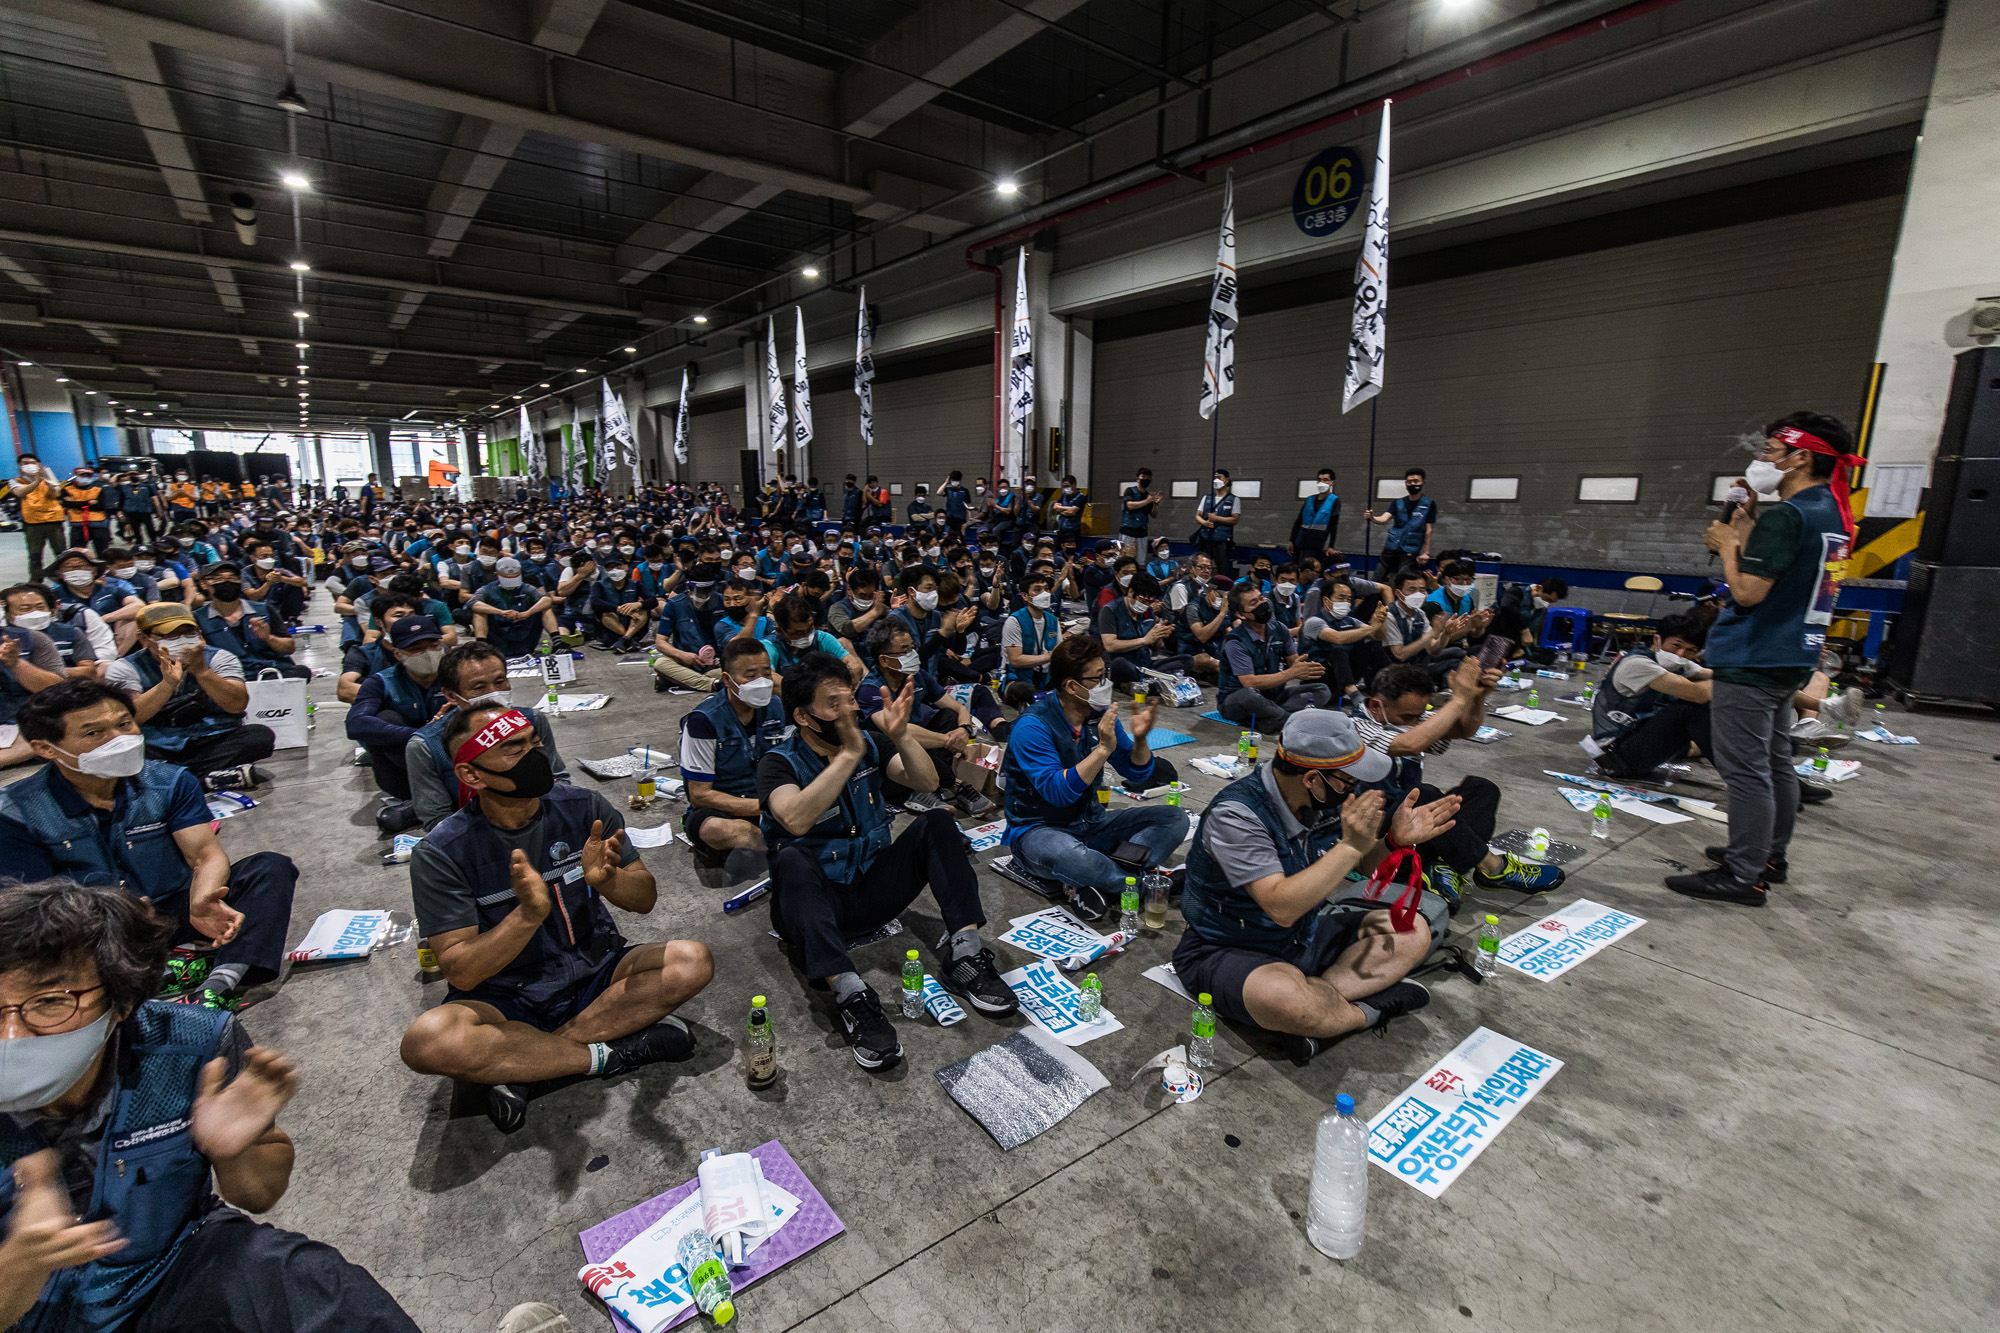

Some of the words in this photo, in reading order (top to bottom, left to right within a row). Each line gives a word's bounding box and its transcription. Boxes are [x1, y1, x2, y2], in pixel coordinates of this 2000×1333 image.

[1305, 158, 1352, 205] 06
[1304, 206, 1347, 229] C동3층
[264, 708, 292, 718] CAF
[475, 717, 515, 748] 단결
[1010, 929, 1079, 959] 우정본
[1519, 936, 1595, 976] 우정본부가
[1014, 986, 1073, 1030] 분류작업!
[1424, 1068, 1464, 1093] 즉각
[1368, 1099, 1435, 1159] 분류작업!
[1397, 1100, 1501, 1184] 우정본부가
[1472, 1047, 1552, 1108] 책임져라!
[582, 1260, 637, 1296] 즉각
